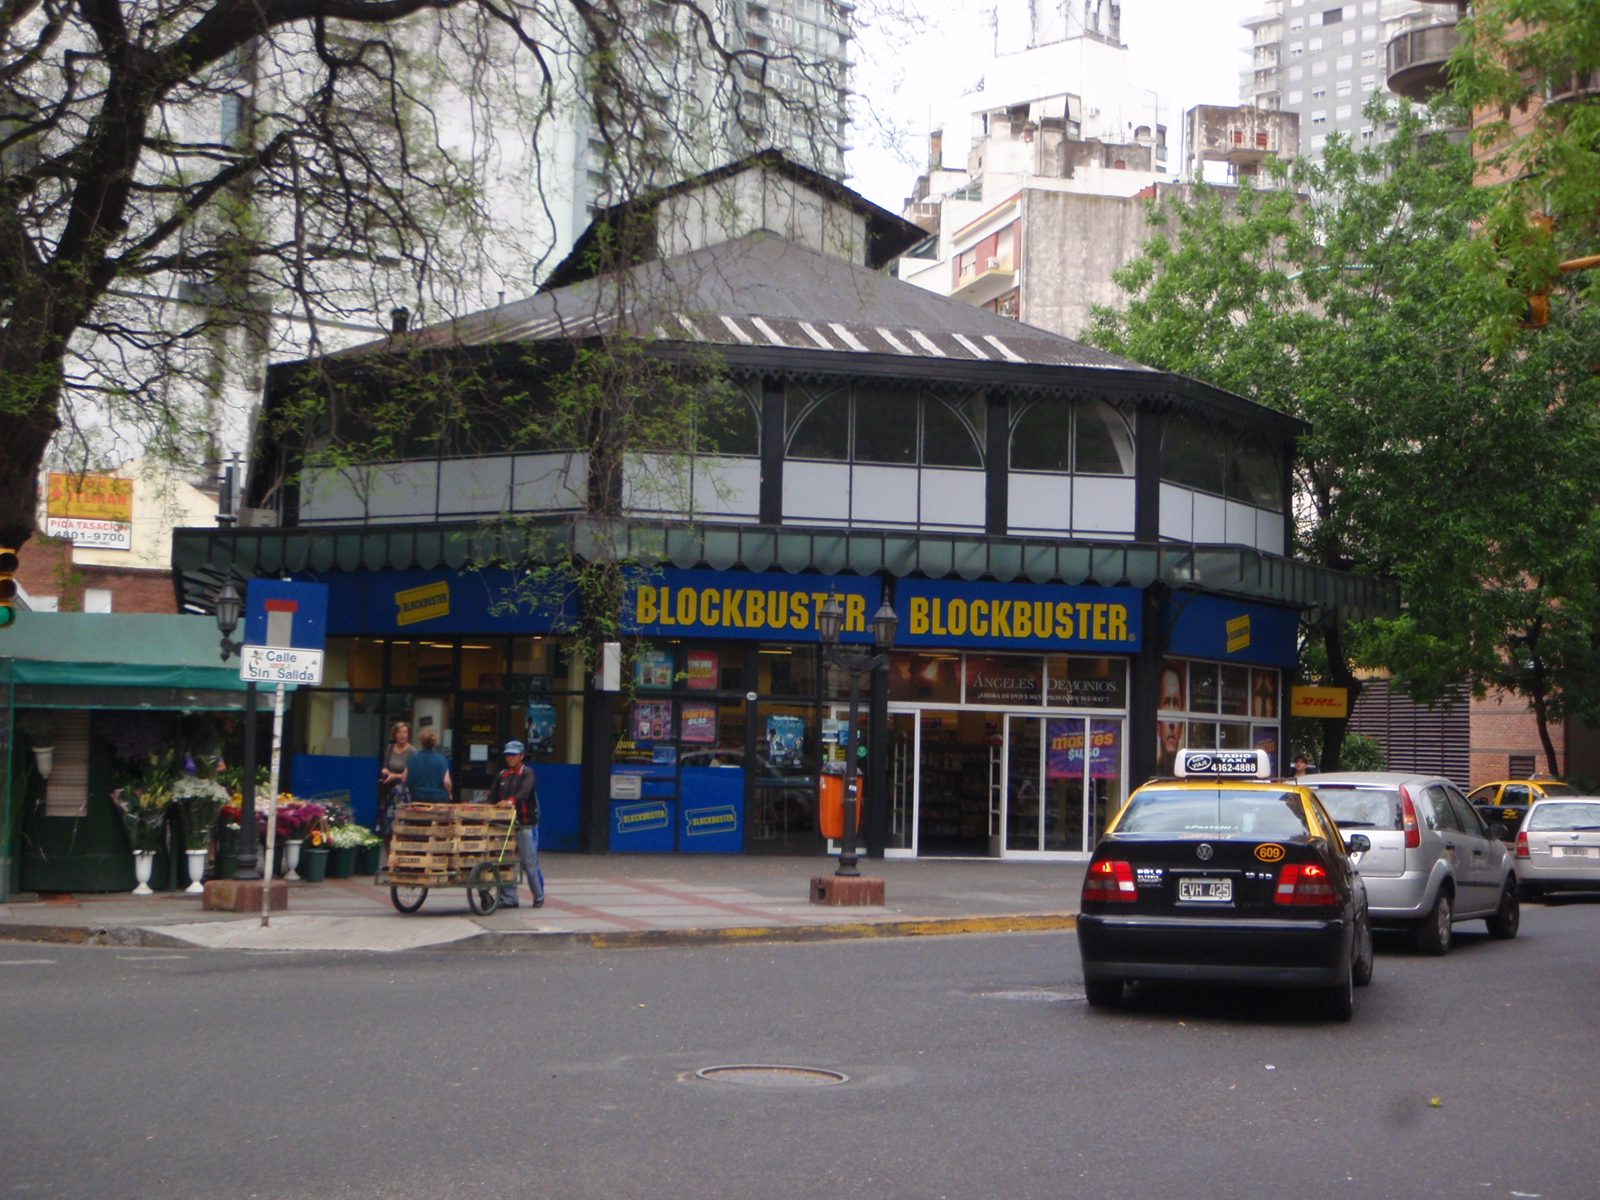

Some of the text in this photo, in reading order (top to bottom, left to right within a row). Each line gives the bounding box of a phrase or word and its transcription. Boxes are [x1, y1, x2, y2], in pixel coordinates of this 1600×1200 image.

[50, 520, 73, 529] PIDA
[54, 530, 125, 542] 4801-9700
[909, 597, 1127, 640] BLOCKBUSTER
[266, 650, 297, 662] Calle
[250, 667, 314, 681] Sin Salida
[973, 672, 1117, 692] ÁNGELES DEMONIOS
[1301, 697, 1337, 706] DHL
[1052, 733, 1115, 751] mares
[1259, 847, 1281, 859] 609
[1180, 883, 1203, 897] EVH
[1208, 884, 1231, 897] 425
